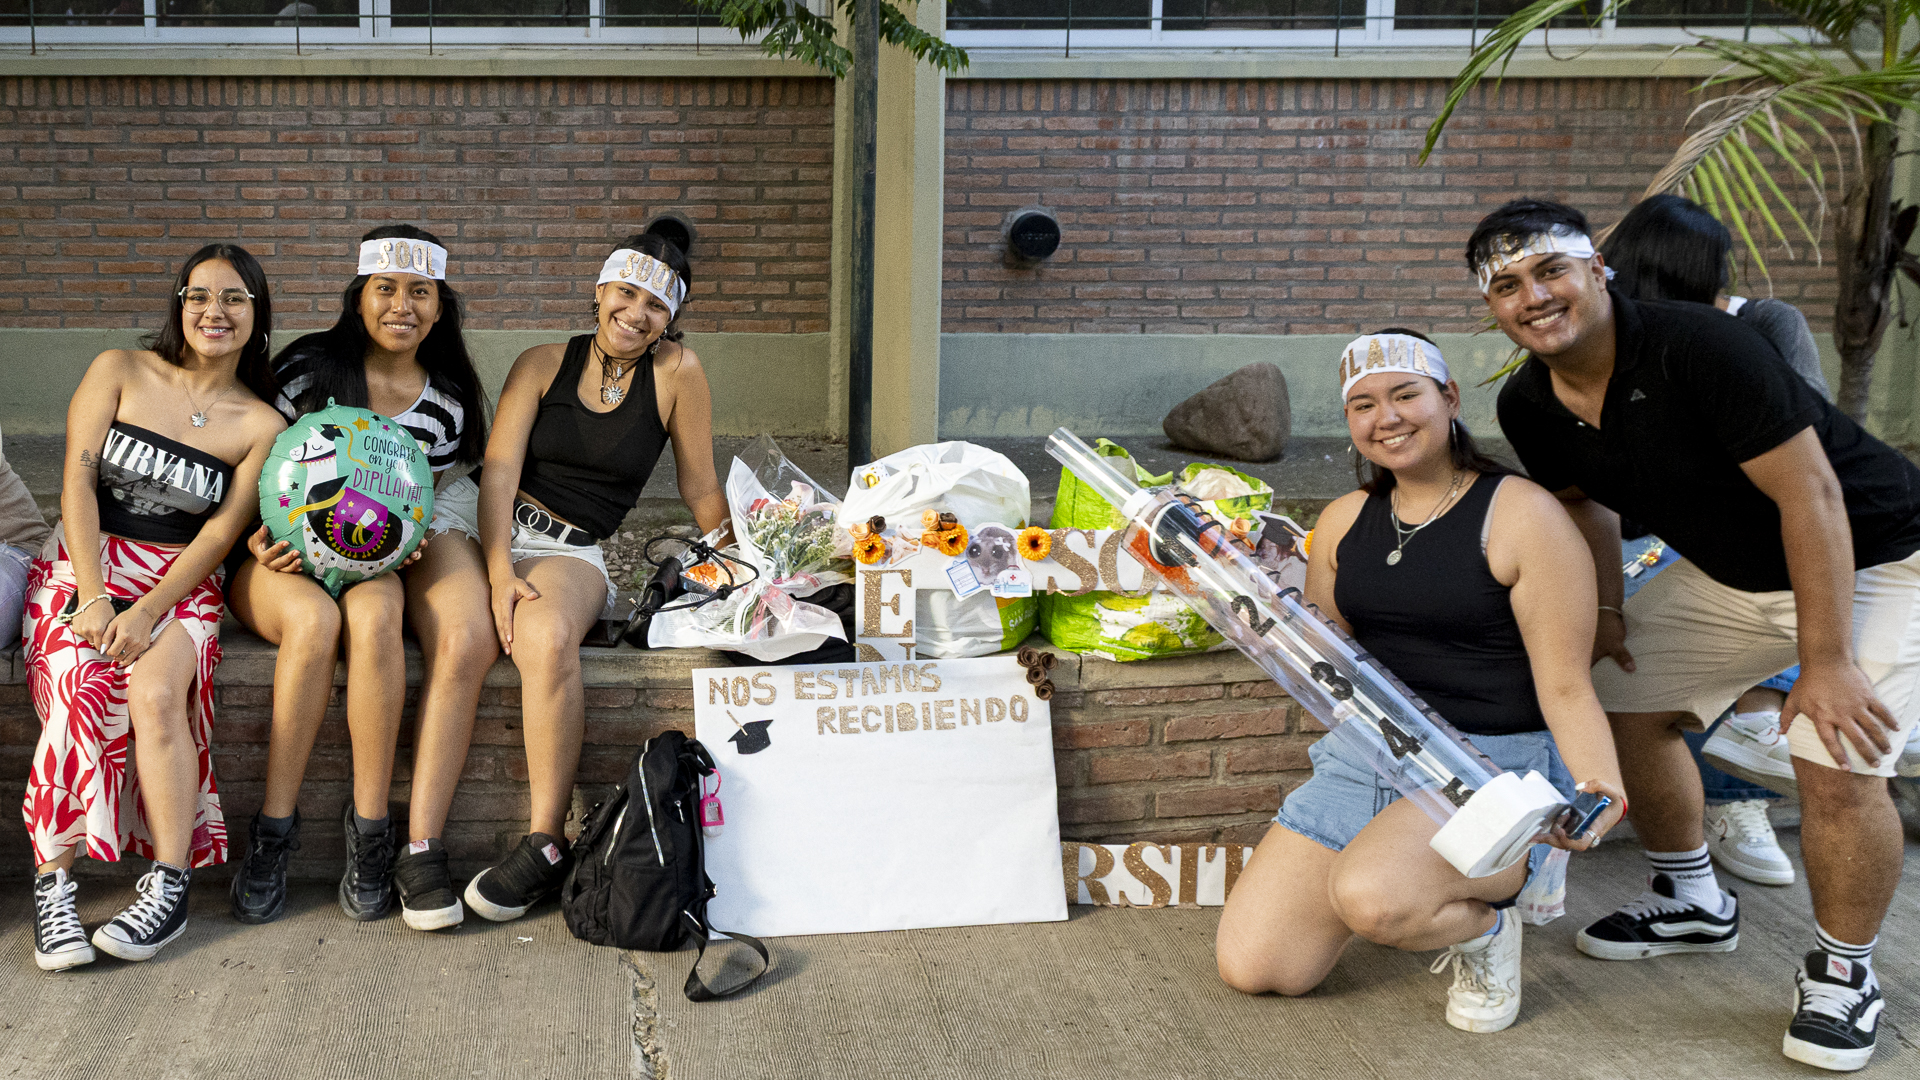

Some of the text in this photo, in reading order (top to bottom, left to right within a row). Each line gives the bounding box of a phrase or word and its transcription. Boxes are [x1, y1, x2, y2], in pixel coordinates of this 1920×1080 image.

[376, 241, 436, 276] SOOL
[619, 253, 677, 300] SOOL
[364, 435, 416, 462] CONGRATS
[369, 454, 382, 466] on
[353, 468, 423, 504] DIPLLAMA!
[709, 663, 941, 707] NOS ESTAMOS
[1231, 595, 1277, 637] 2
[1310, 661, 1354, 700] 3
[1378, 717, 1423, 760] 4
[816, 695, 1029, 735] RECIBIENDO
